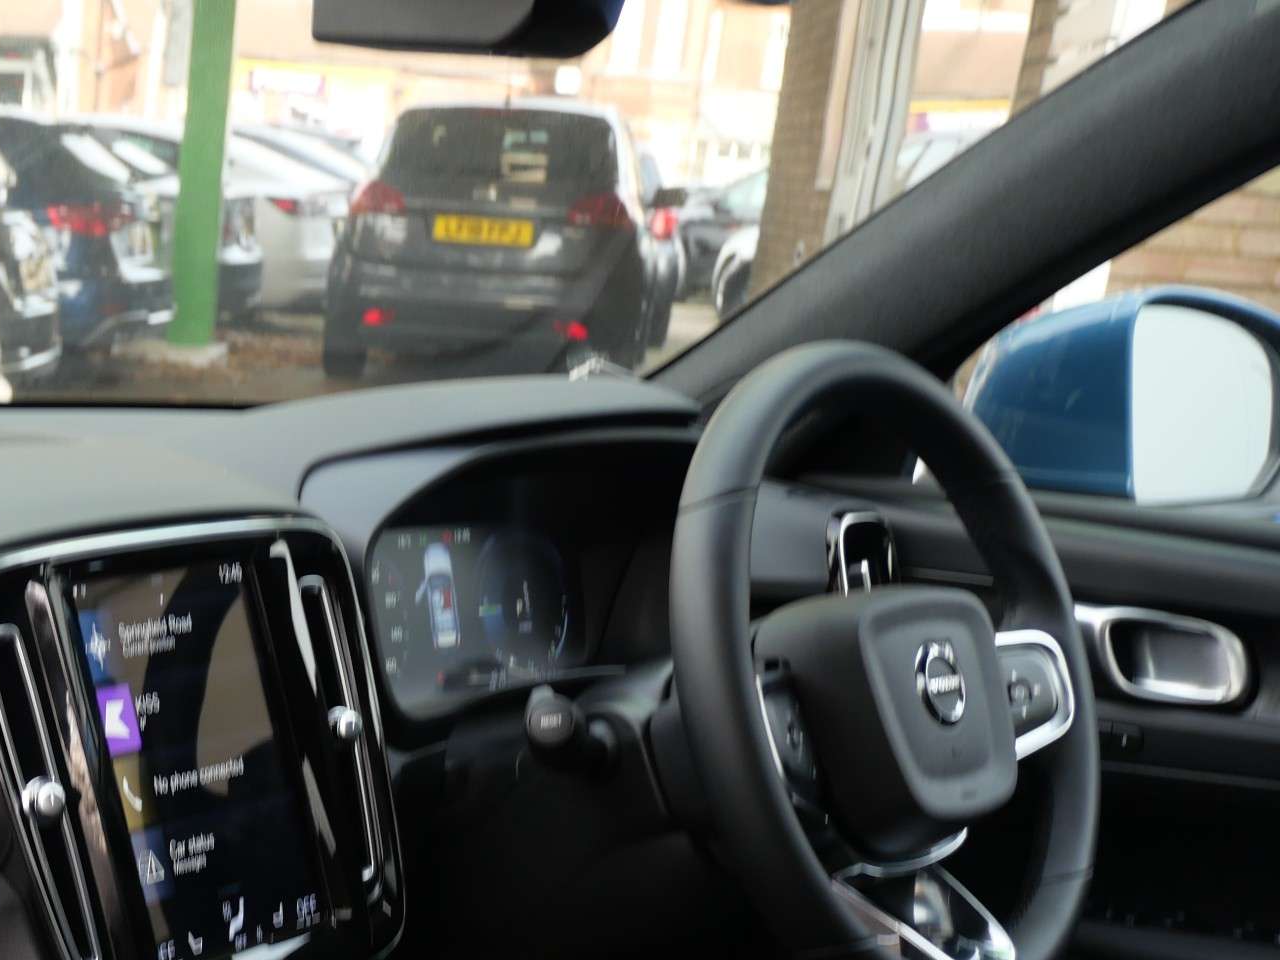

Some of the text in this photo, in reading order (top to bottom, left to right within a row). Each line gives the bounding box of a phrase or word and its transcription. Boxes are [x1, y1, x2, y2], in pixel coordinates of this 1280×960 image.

[168, 611, 193, 634] Road
[153, 755, 244, 796] No phone connected
[170, 832, 215, 860] Car status
